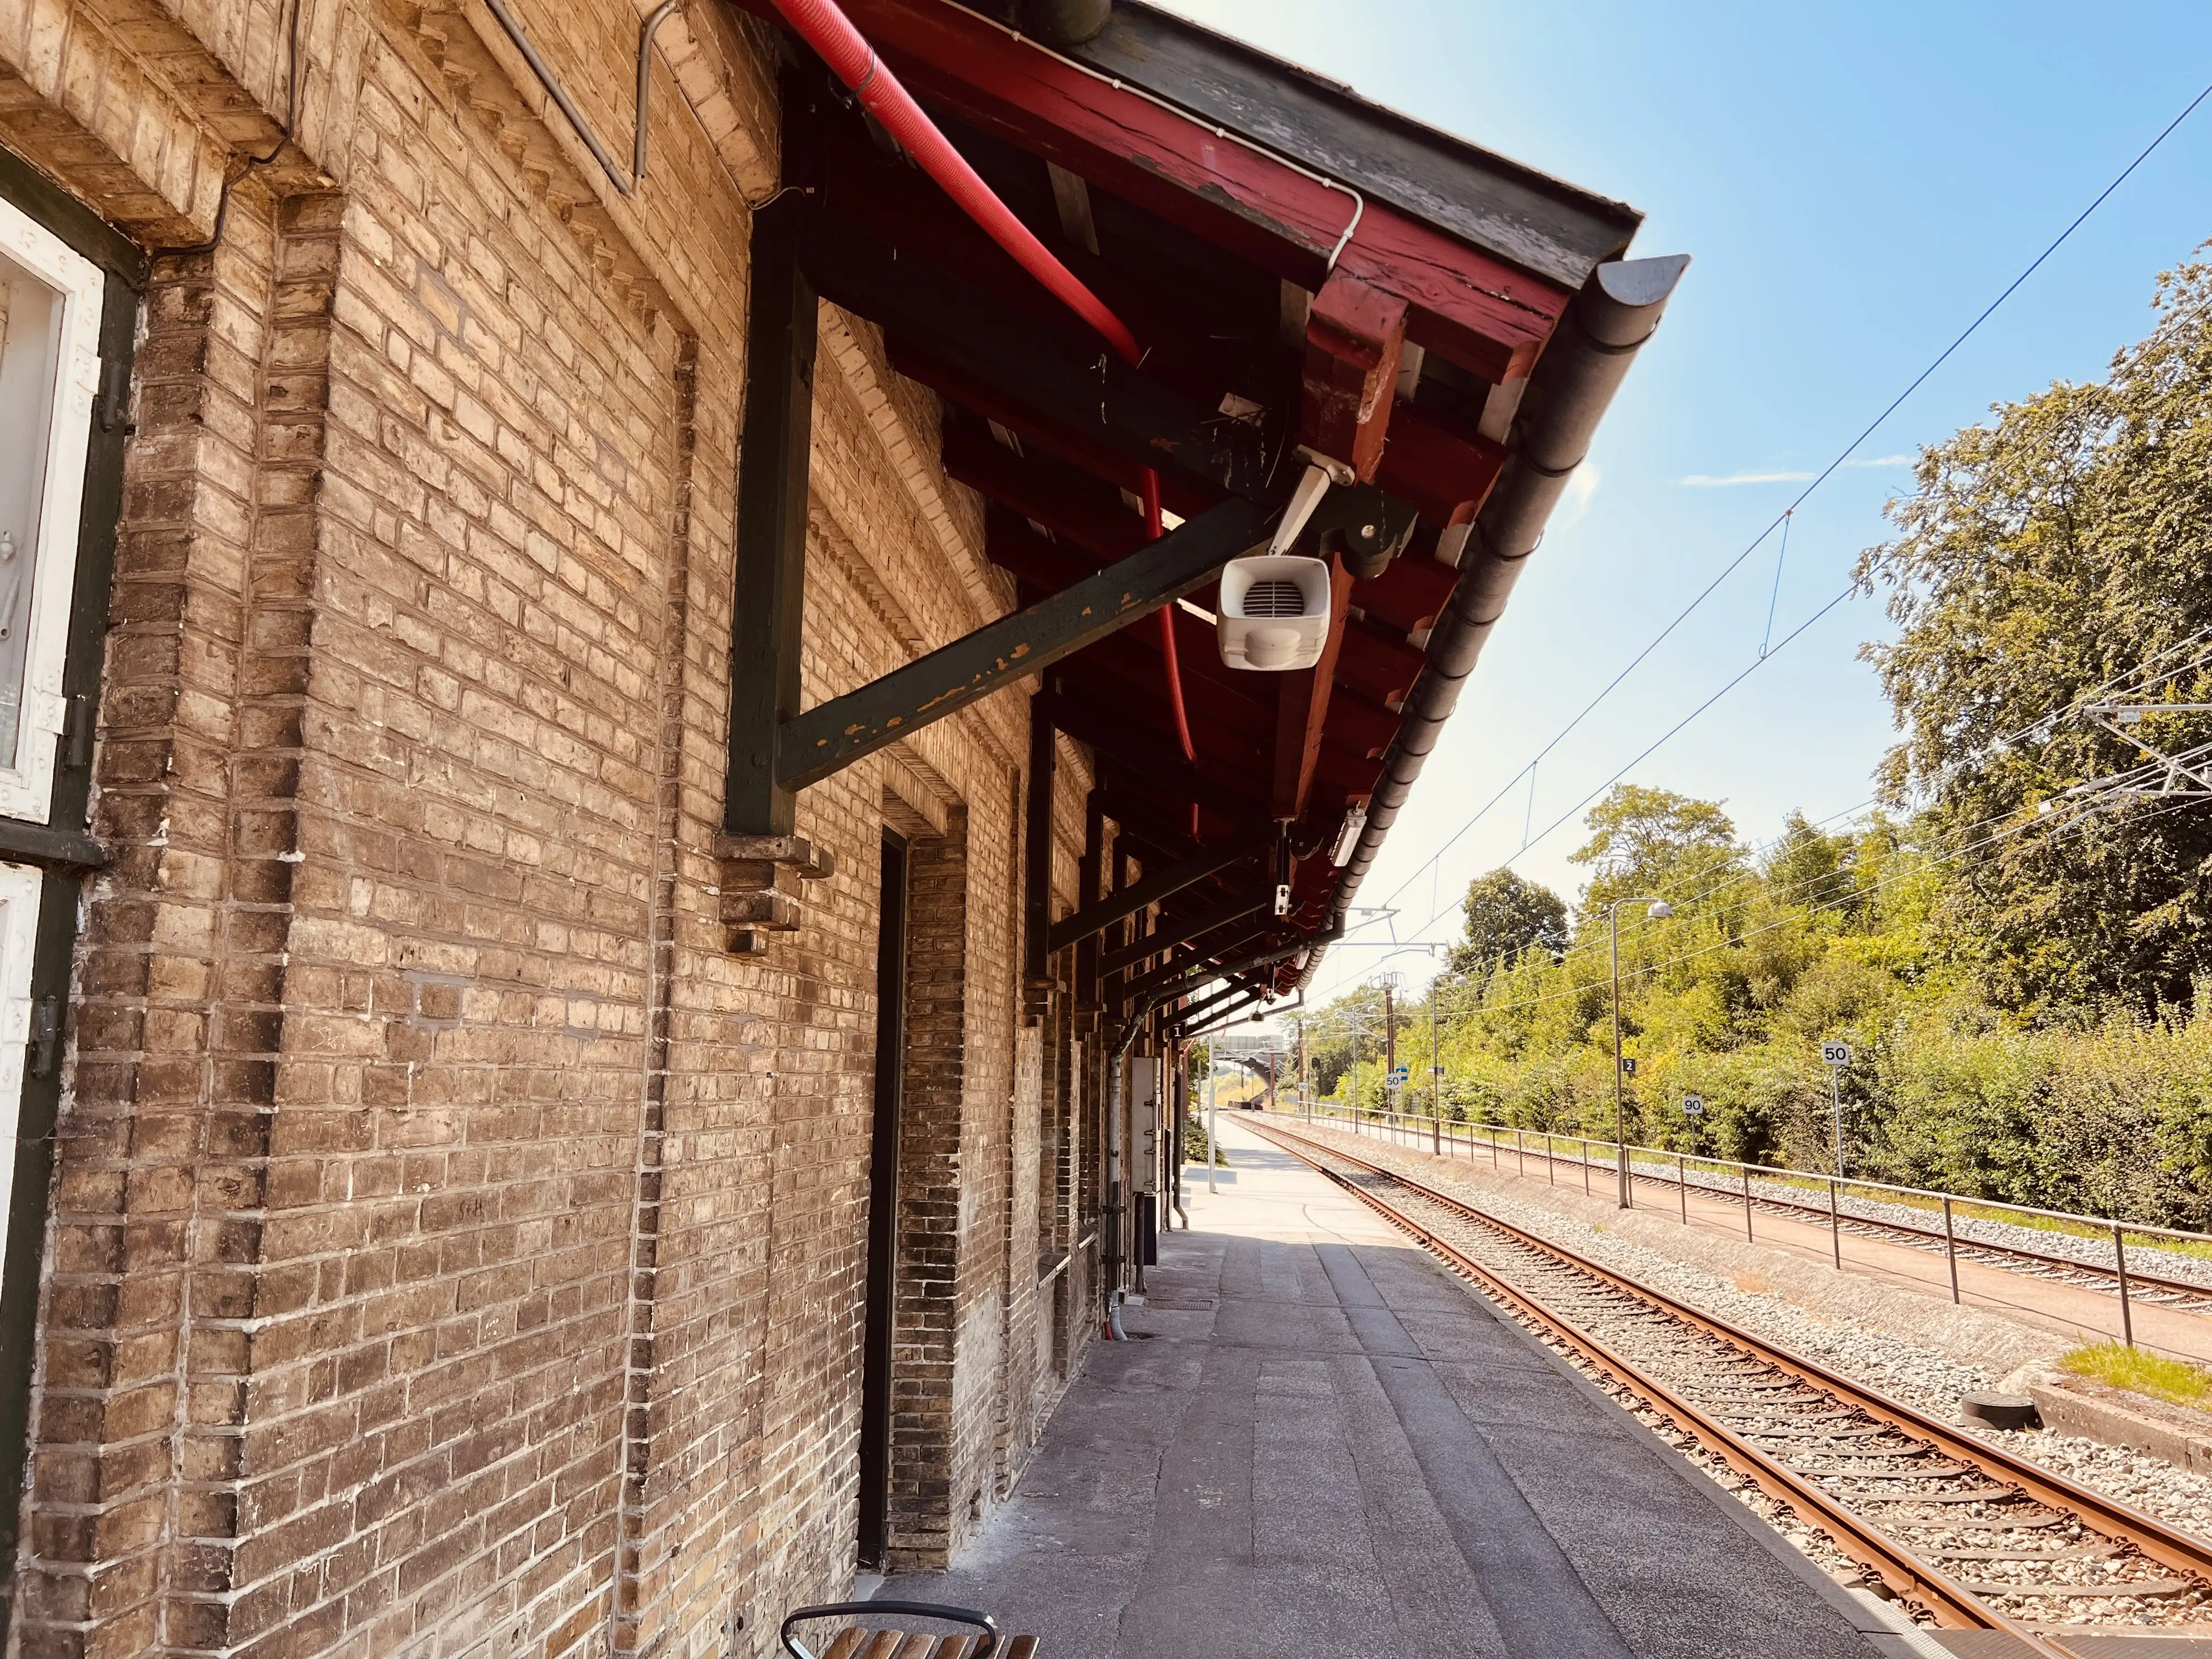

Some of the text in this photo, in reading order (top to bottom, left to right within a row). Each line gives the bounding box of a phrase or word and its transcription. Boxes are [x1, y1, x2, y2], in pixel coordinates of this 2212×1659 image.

[1175, 1027, 1181, 1037] 1
[1826, 1047, 1846, 1060] 50
[1627, 1062, 1633, 1070] 2
[1386, 1077, 1399, 1085] 50
[1685, 1100, 1700, 1110] 90
